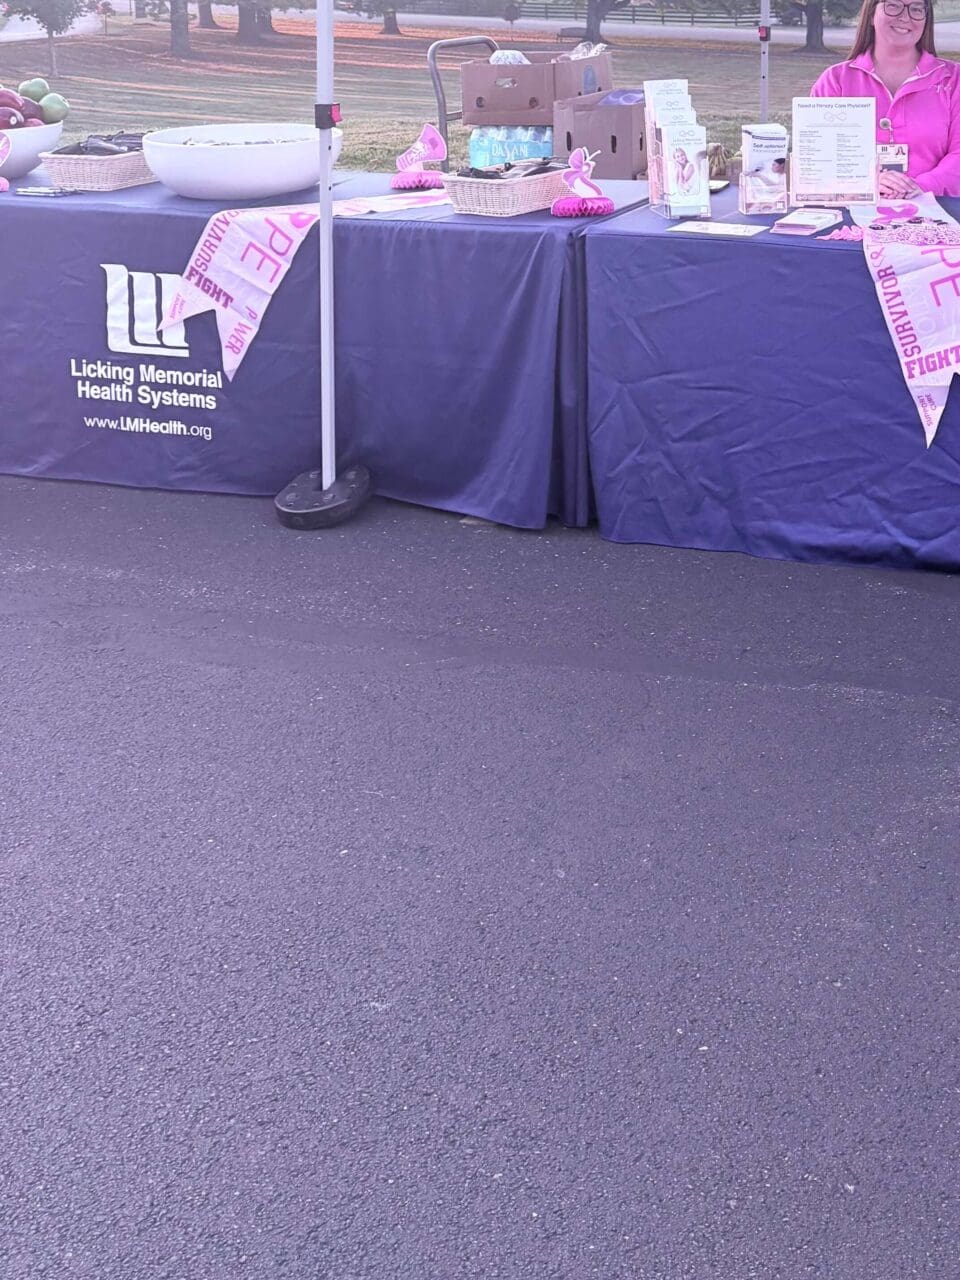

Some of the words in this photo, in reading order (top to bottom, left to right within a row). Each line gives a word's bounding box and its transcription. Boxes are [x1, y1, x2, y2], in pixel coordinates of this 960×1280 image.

[492, 142, 528, 161] DASANI
[185, 266, 234, 309] FIGHT
[876, 265, 922, 358] SURVIVOR
[70, 358, 134, 386] Licking
[139, 364, 223, 389] Memorial
[77, 380, 133, 403] Health
[137, 385, 217, 410] Systems
[83, 416, 212, 441] www.LMHealth.org
